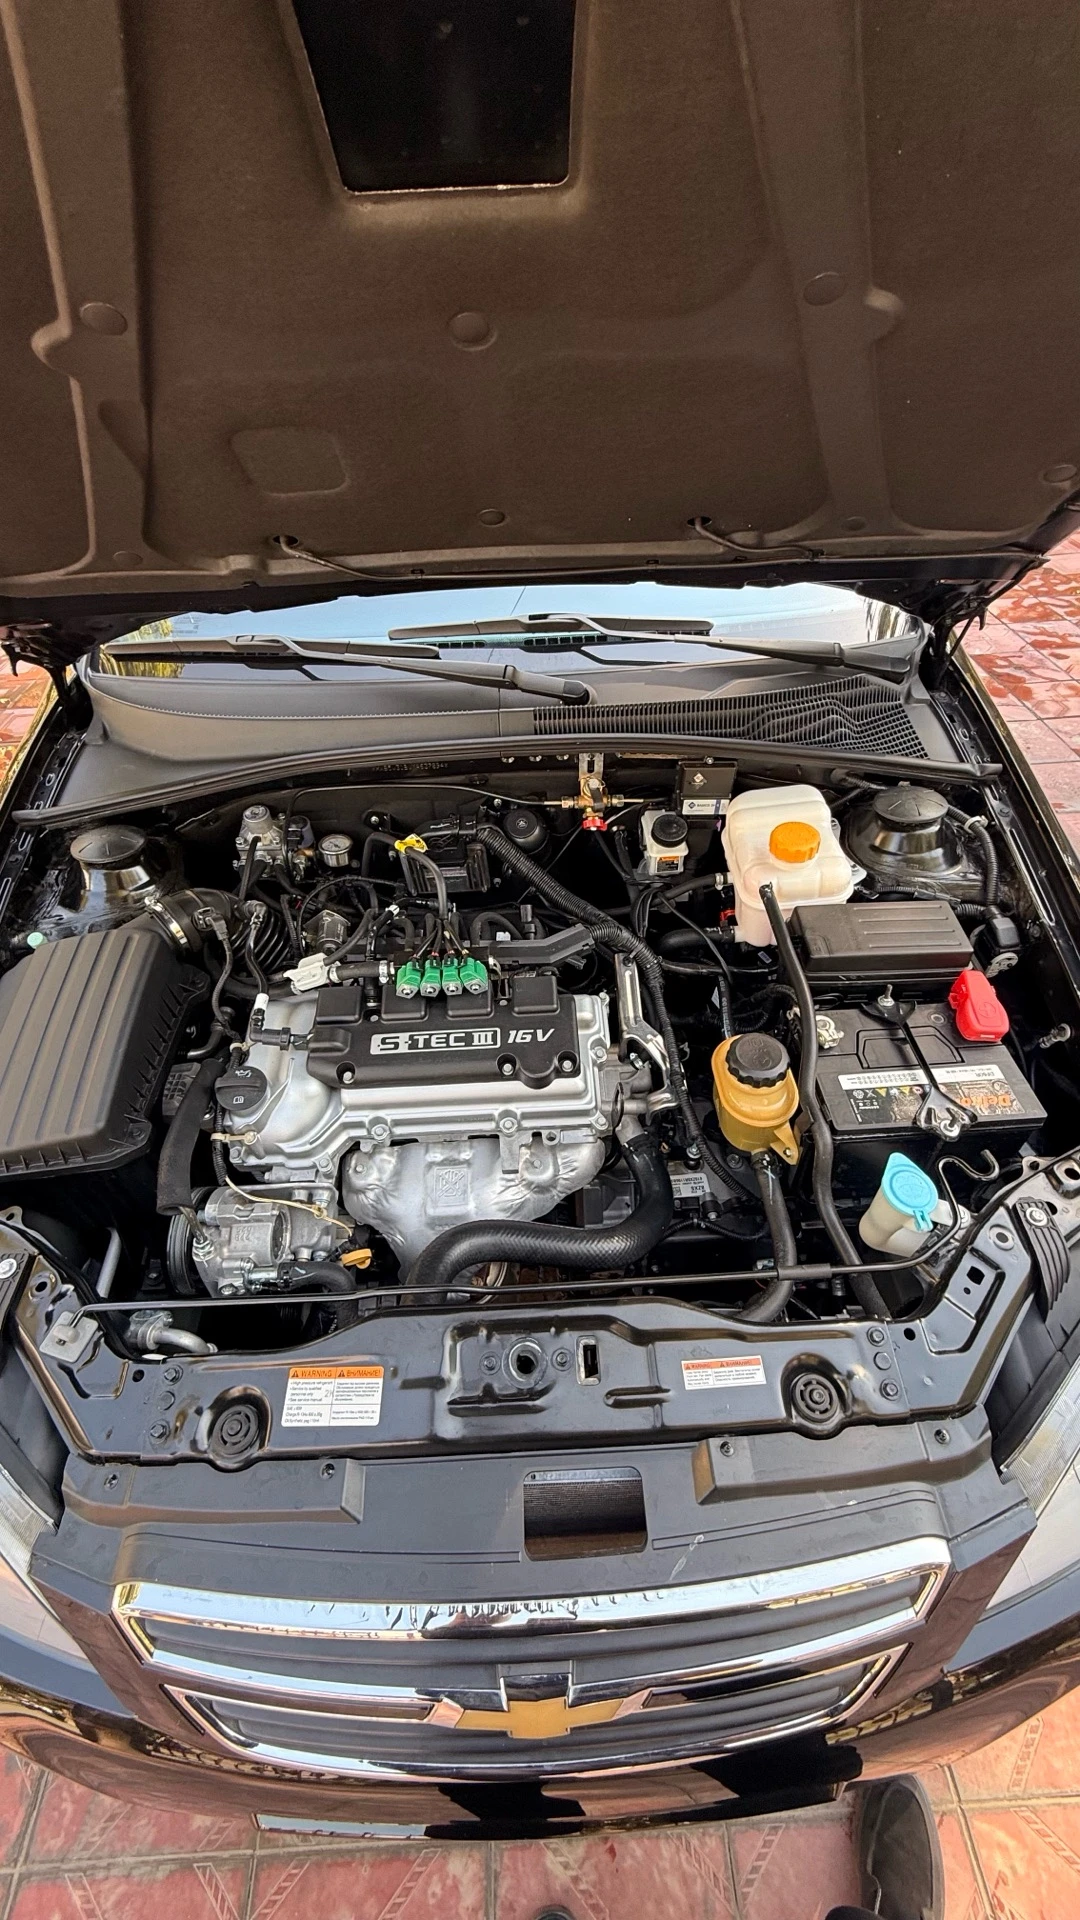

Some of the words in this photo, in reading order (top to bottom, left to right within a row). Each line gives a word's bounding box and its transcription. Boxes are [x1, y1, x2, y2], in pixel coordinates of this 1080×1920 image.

[471, 1031, 494, 1046] III
[507, 1028, 555, 1044] 16V
[960, 1094, 1012, 1108] Delko
[301, 1369, 332, 1377] WARNING
[346, 1368, 381, 1377] ВНИМАНИЕ!
